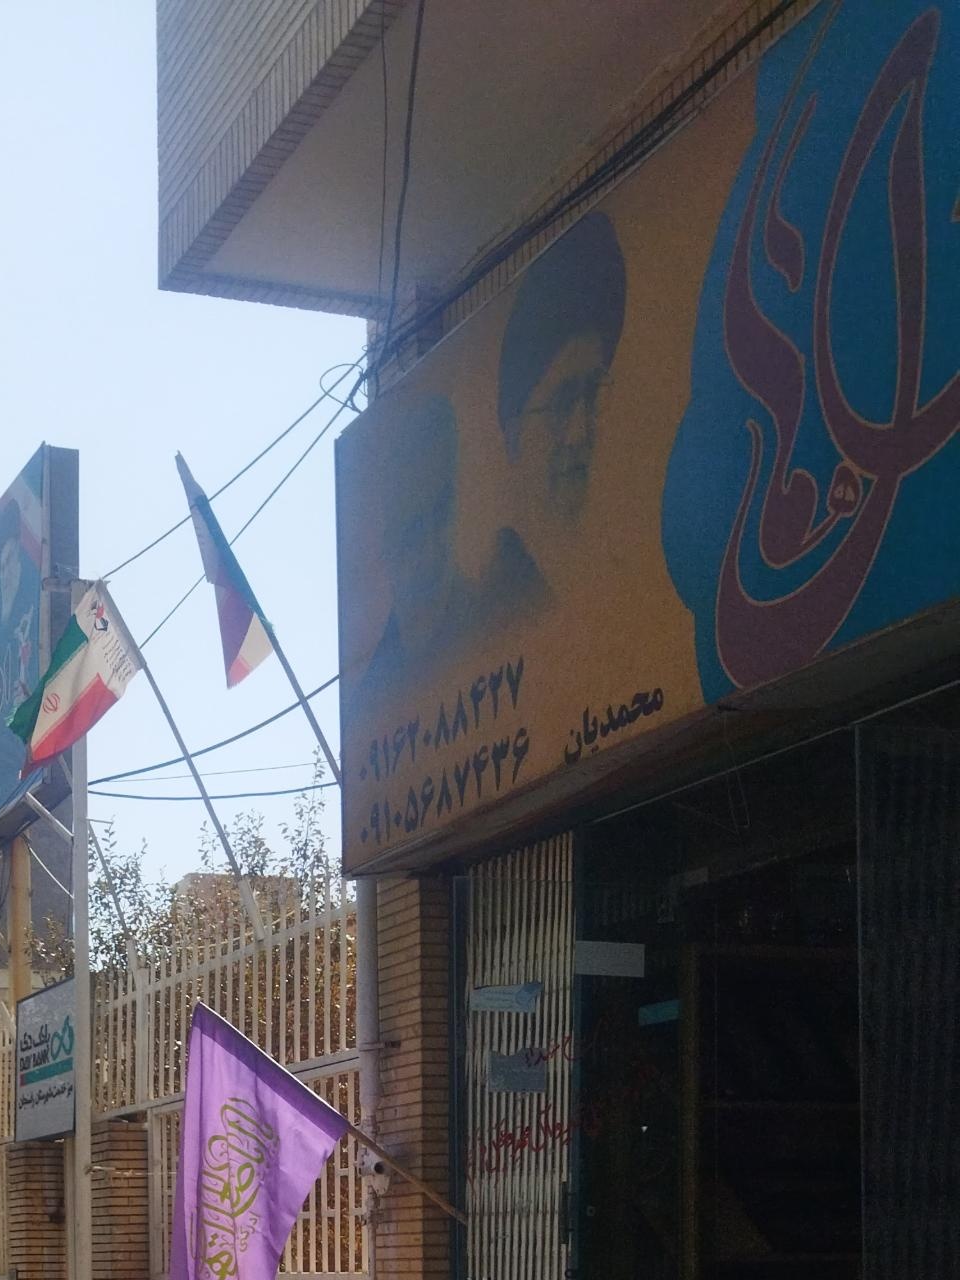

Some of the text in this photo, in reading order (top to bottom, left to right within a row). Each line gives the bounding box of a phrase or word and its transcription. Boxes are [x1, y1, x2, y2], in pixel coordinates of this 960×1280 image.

[563, 687, 664, 766] محمدیان
[33, 1024, 51, 1048] بانک
[33, 1046, 50, 1068] BANK
